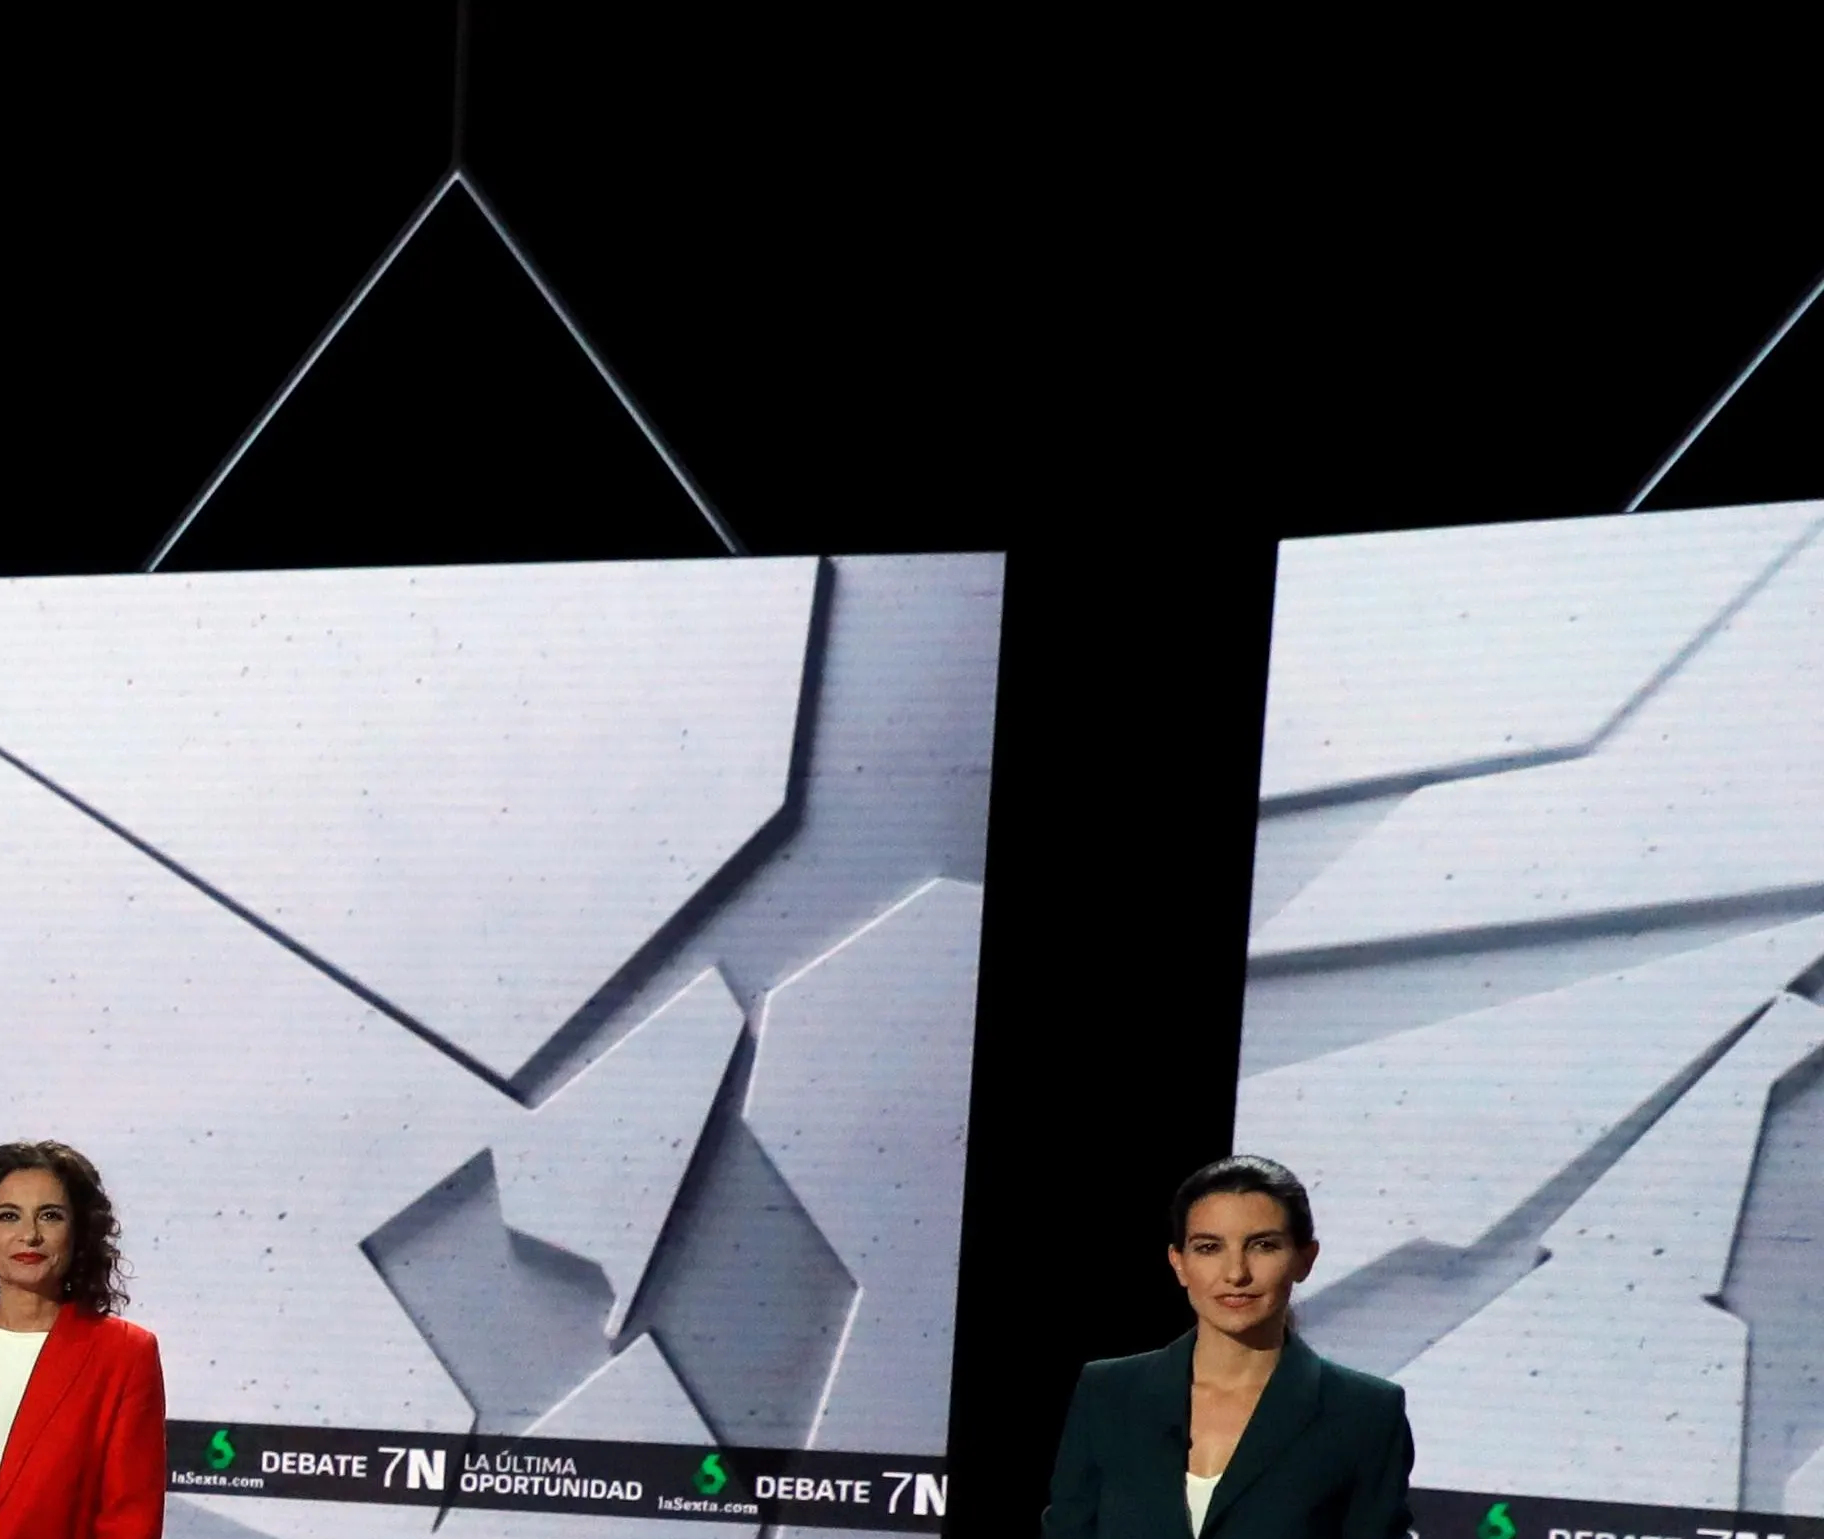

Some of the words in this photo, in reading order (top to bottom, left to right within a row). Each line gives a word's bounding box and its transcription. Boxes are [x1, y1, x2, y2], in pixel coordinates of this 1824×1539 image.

[262, 1451, 368, 1477] DEBATE
[378, 1446, 446, 1490] 7N
[464, 1453, 490, 1471] LA
[496, 1449, 577, 1475] ÚLTIMA
[172, 1470, 264, 1488] laSexta.com
[460, 1473, 643, 1501] OPORTUNIDAD
[658, 1495, 758, 1515] laSexta.com
[756, 1475, 871, 1503] DEBATE
[882, 1471, 948, 1516] 7N
